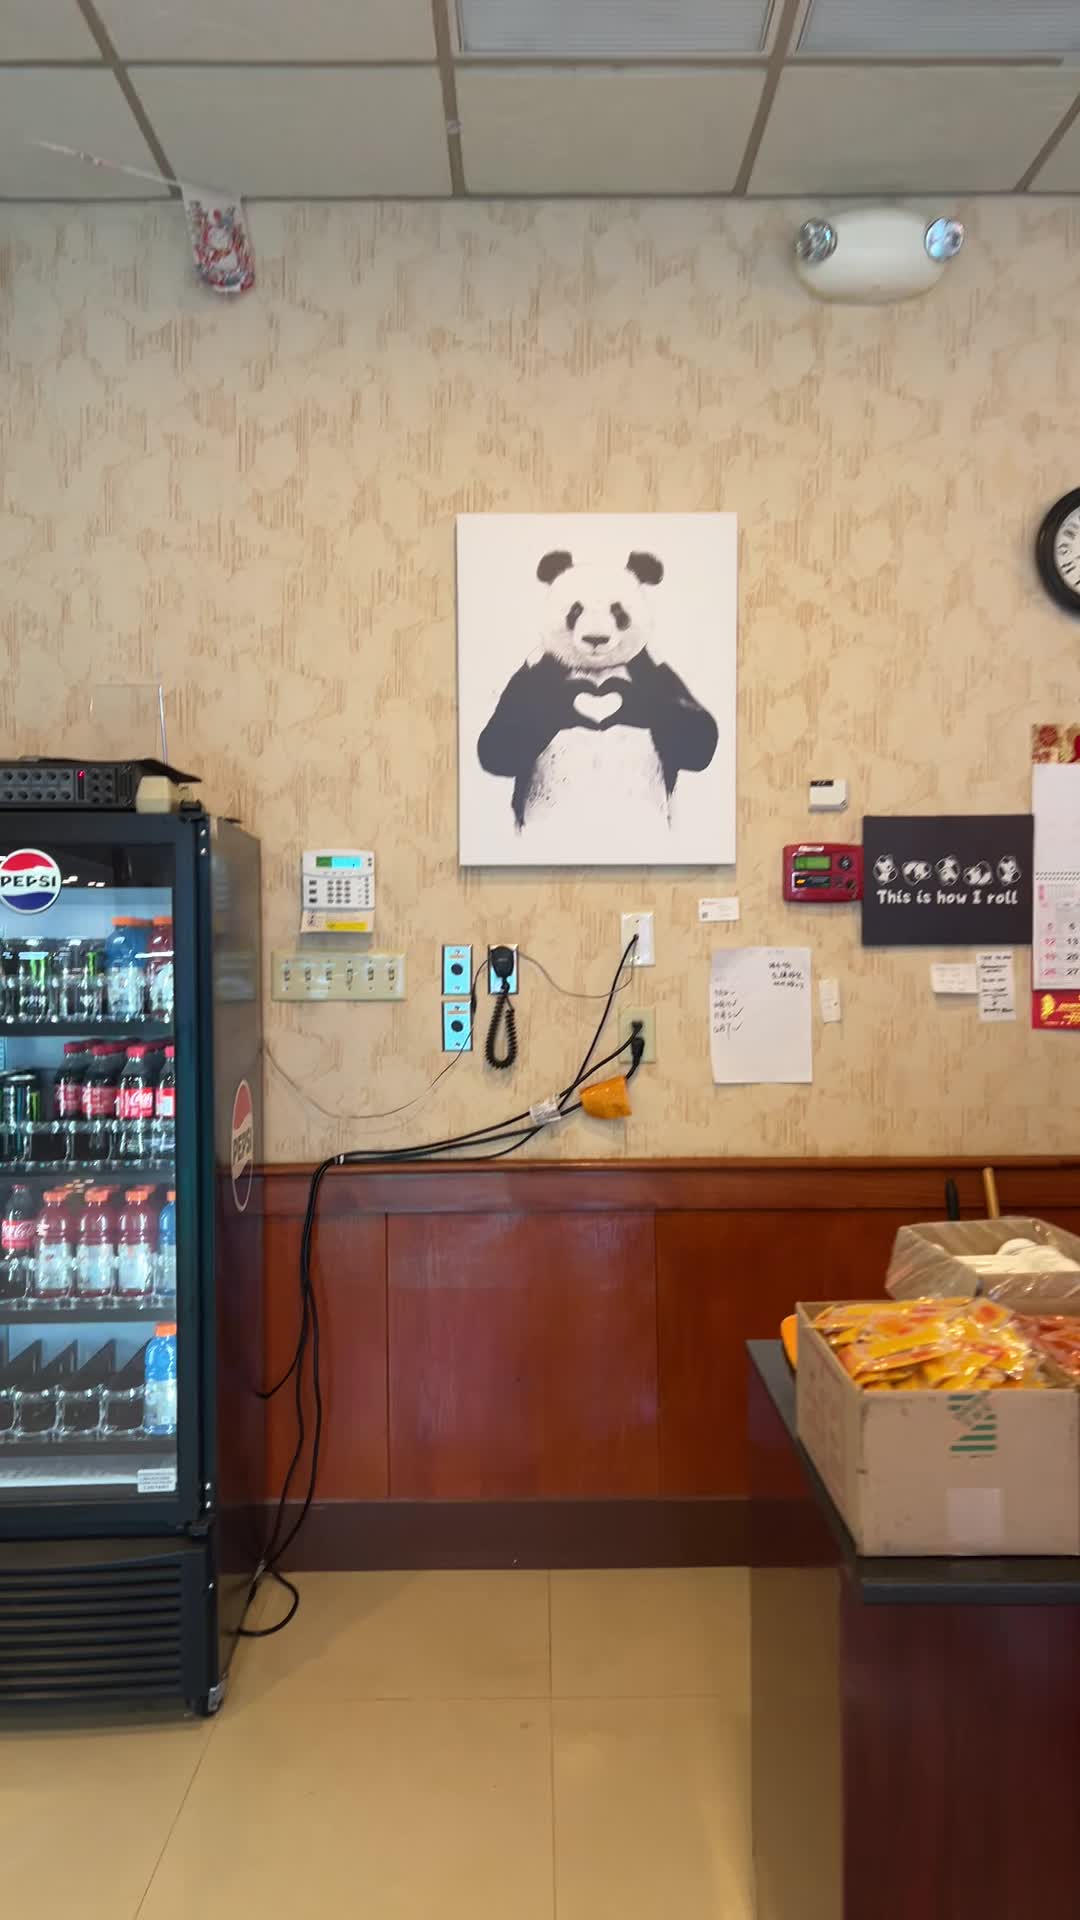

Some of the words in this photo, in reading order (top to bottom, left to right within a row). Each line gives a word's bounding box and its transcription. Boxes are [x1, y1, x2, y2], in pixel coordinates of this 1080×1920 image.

[1, 875, 56, 887] PEPSI
[876, 889, 911, 904] This
[916, 889, 932, 904] is
[937, 890, 967, 904] how
[972, 889, 982, 904] I
[986, 890, 1018, 904] roll
